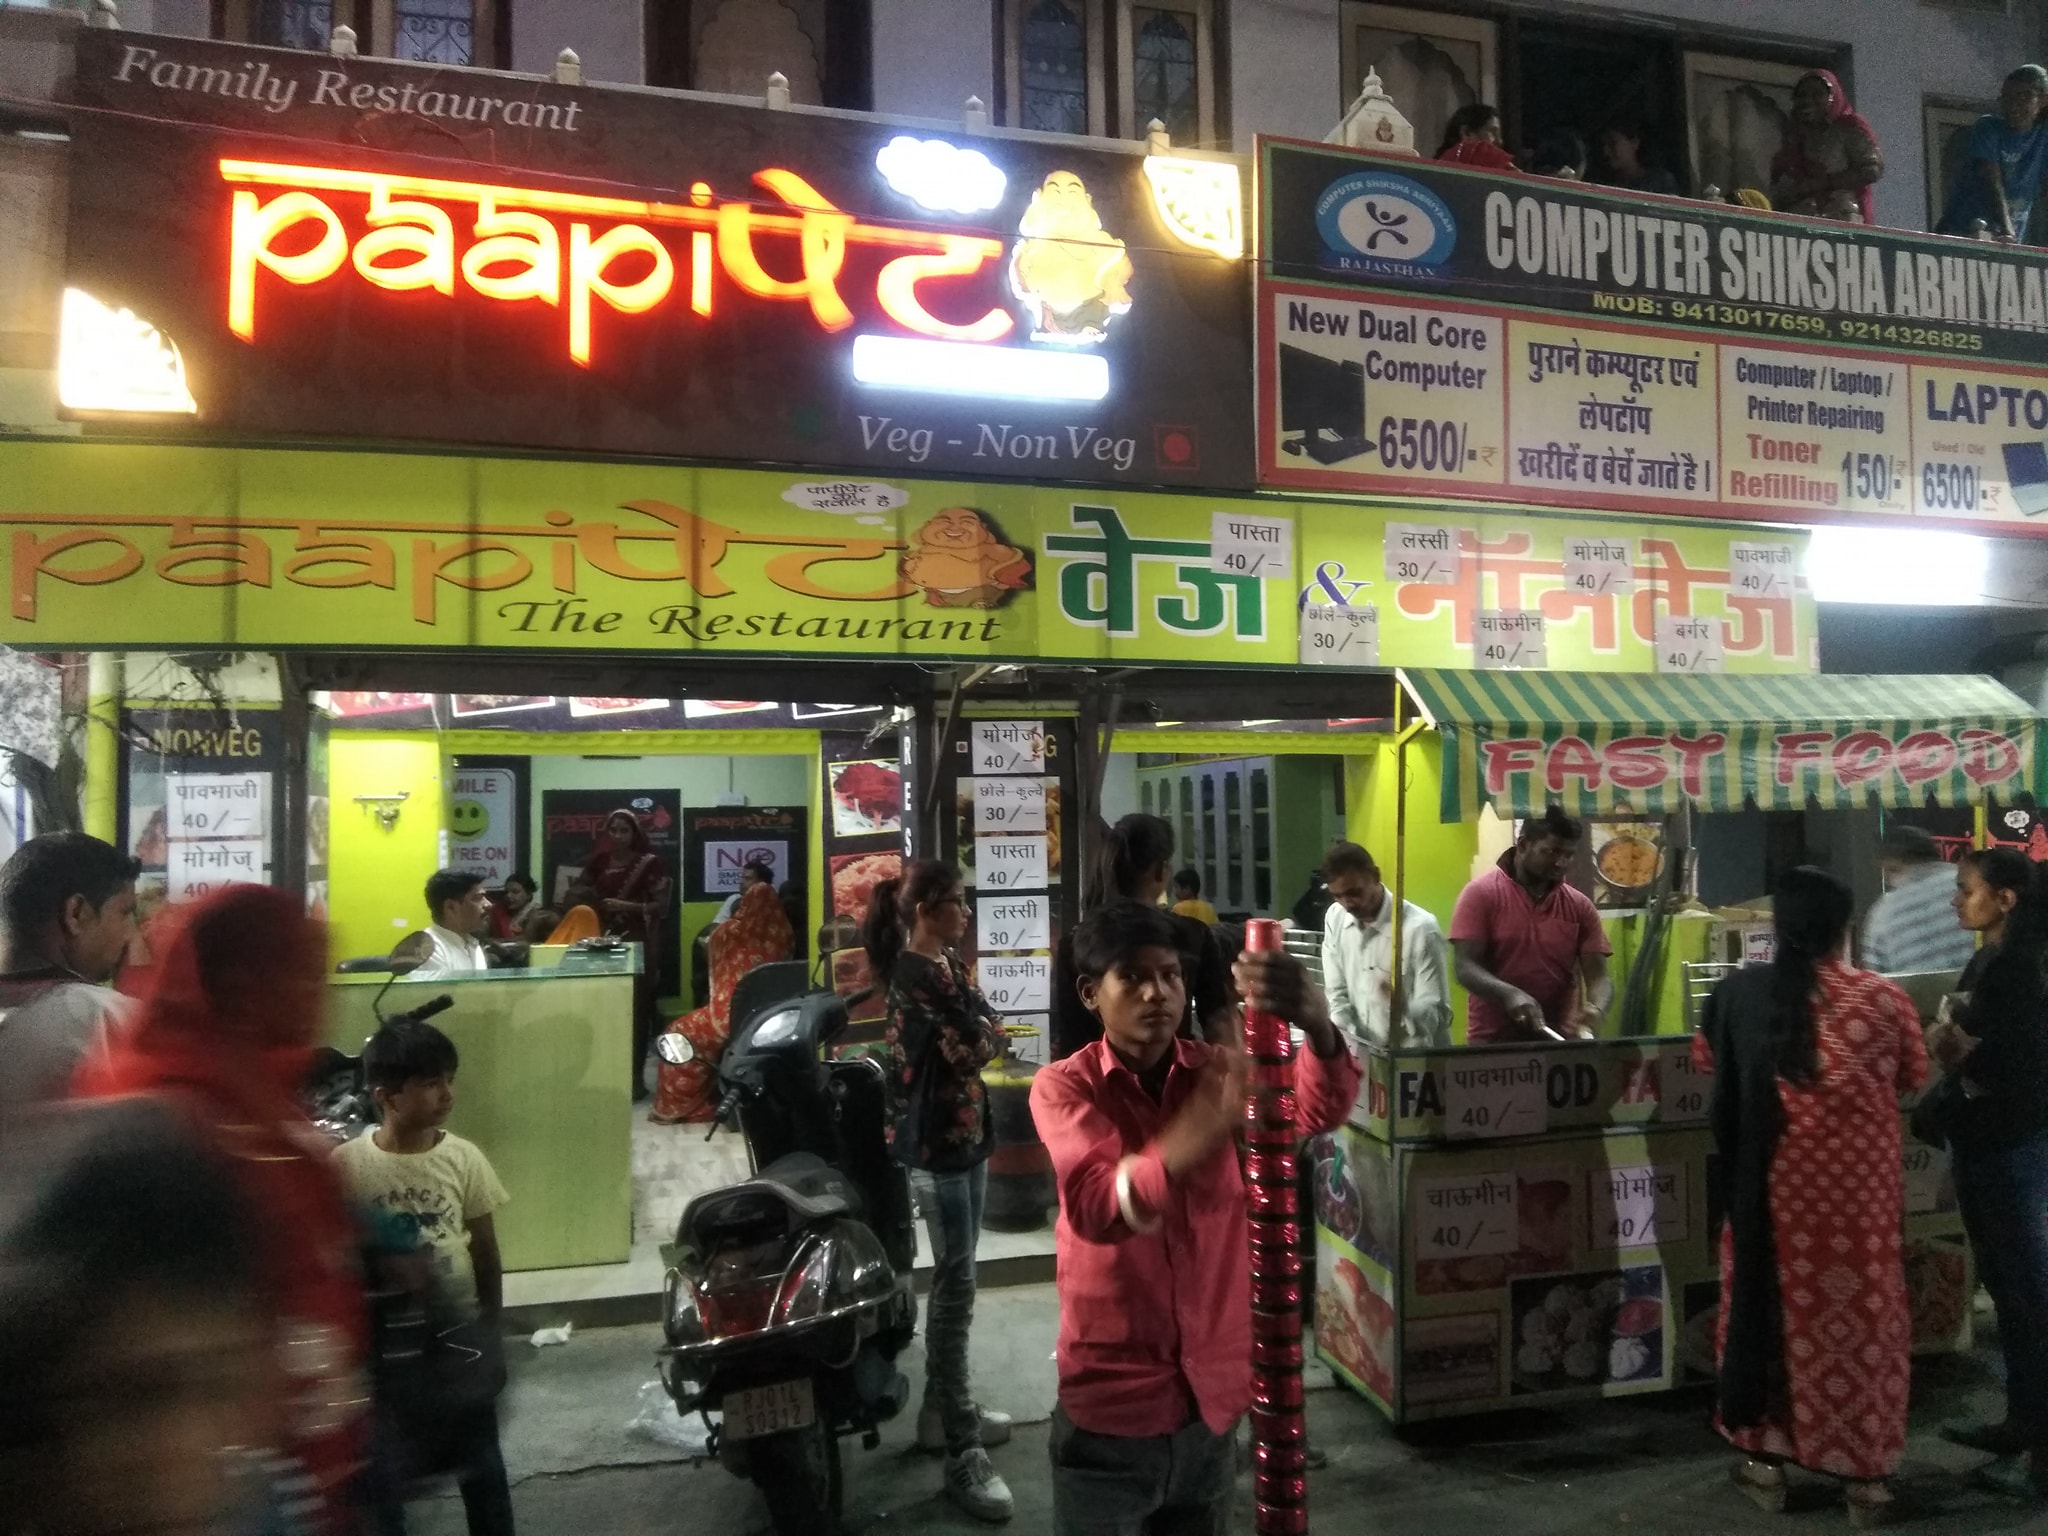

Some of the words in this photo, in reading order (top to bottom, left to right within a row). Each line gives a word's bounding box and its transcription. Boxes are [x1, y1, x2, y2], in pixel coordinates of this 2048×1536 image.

[112, 44, 299, 115] Family
[309, 68, 583, 133] Restaurant
[1318, 180, 1363, 216] COMPUTER
[1365, 179, 1410, 195] SHIKSHA
[1340, 257, 1437, 279] RAJASTHAN
[1485, 191, 1711, 296] COMPUTER
[1718, 226, 1888, 314] SHIKSHA
[1893, 249, 2048, 335] ABHIYAA
[1288, 301, 1350, 337] New
[1358, 309, 1417, 345] Dual
[1426, 316, 1488, 351] Core
[1593, 293, 1664, 317] MOB:
[1671, 300, 1834, 338] 9413017659,
[1839, 320, 1983, 351] 9214326825
[1365, 350, 1488, 392] Computer
[1528, 337, 1581, 383] पुराने
[1585, 348, 1665, 394] कम्प्यूटर
[1669, 350, 1700, 388] एवं
[1736, 357, 1817, 391] Computer
[1830, 367, 1883, 399] Laptop
[1578, 392, 1653, 435] लेपटॉप
[1748, 395, 1805, 425] Printer
[1807, 401, 1885, 435] Repairing
[857, 414, 933, 463] Veg
[1746, 432, 1822, 465] Toner
[1518, 442, 1580, 481] खरीदें
[1583, 453, 1599, 483] व
[1602, 446, 1635, 486] बेचें
[1637, 451, 1680, 490] जाते
[1730, 470, 1839, 506] Refilling
[1229, 522, 1281, 544] पास्ता
[1401, 528, 1449, 551] लस्सी
[1573, 540, 1627, 566] मोमोज्
[1735, 546, 1792, 564] पावभाजी
[1044, 504, 1266, 640] वेज
[1298, 562, 1374, 614] &
[498, 598, 624, 634] The
[649, 605, 1002, 642] Restaurant
[1480, 612, 1542, 632] चाऊमीन
[1675, 622, 1710, 640] बर्गर
[153, 728, 262, 757] NONVEG
[1482, 732, 1726, 798] FAST
[1774, 729, 2022, 787] FOOD
[176, 779, 257, 800] पावभाजी
[452, 779, 497, 794] MILE
[183, 845, 254, 873] मोमोज्
[484, 847, 508, 861] ON
[990, 844, 1037, 860] पास्ता
[992, 900, 1038, 920] लस्सी
[986, 960, 1046, 979] चाऊमीन
[1454, 1058, 1543, 1089] पावभाजी
[1426, 1180, 1512, 1209] चाऊमीन
